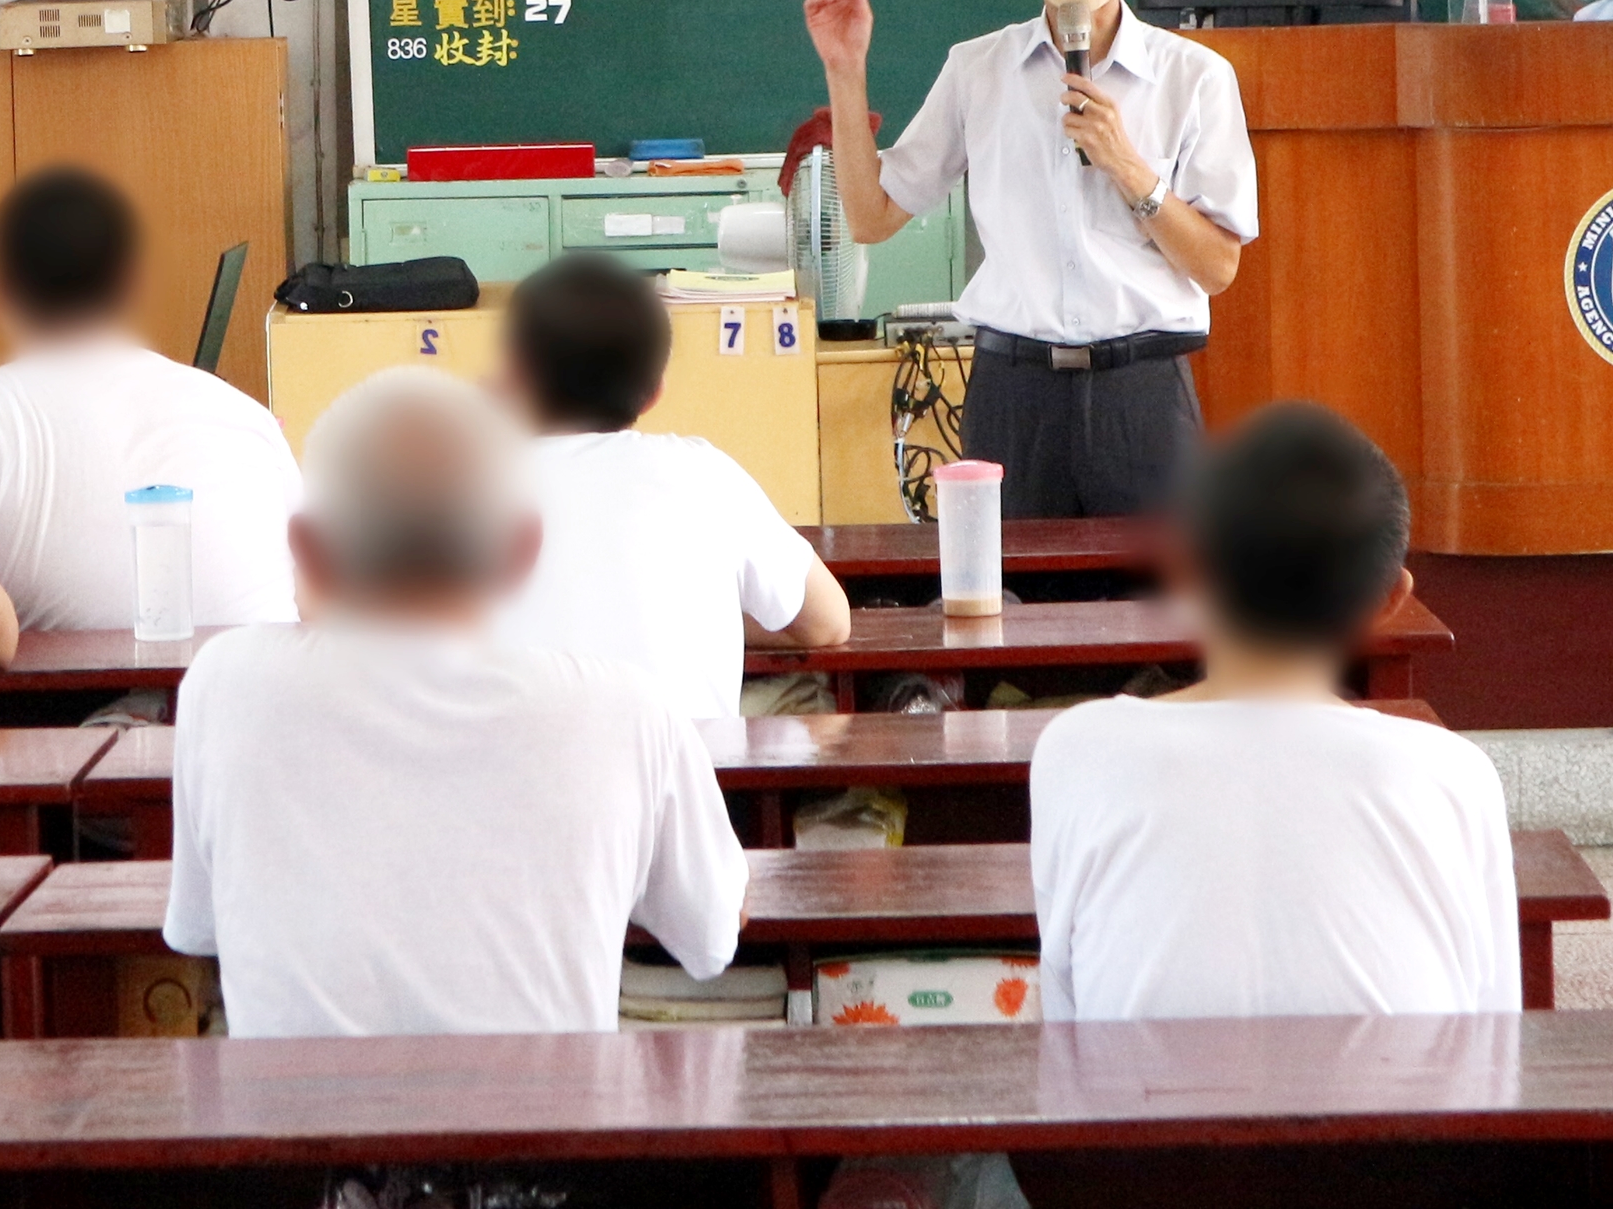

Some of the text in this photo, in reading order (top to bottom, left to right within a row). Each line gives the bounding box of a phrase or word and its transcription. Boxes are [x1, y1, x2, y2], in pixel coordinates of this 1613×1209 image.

[1577, 285, 1613, 349] AGENC
[724, 322, 741, 348] 7
[778, 322, 796, 347] 8
